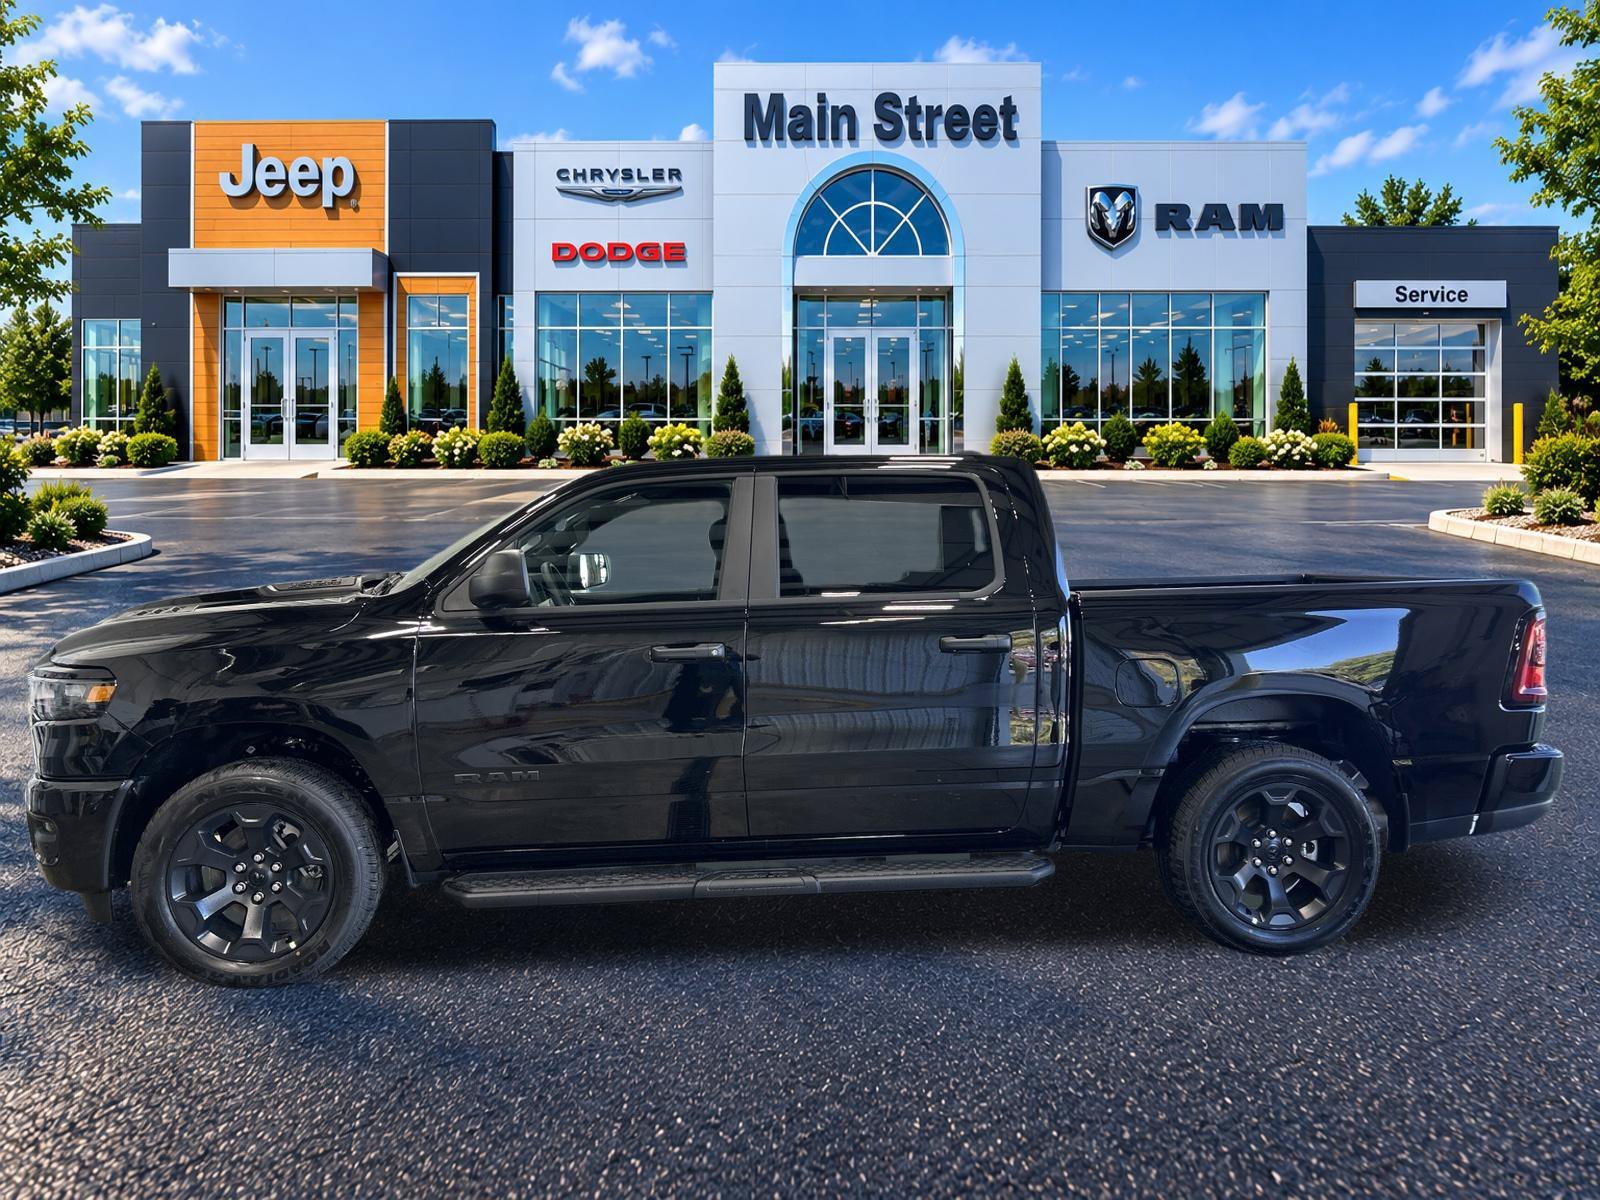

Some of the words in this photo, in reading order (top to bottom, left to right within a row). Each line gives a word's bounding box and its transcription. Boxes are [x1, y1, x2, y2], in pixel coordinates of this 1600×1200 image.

[744, 92, 856, 141] Main
[873, 92, 1018, 141] Street
[218, 143, 355, 208] Jeep
[556, 168, 683, 183] CHRYSLER
[1155, 203, 1285, 231] RAM
[551, 242, 687, 261] DODGE
[1395, 285, 1469, 303] Service
[454, 770, 540, 784] RAM
